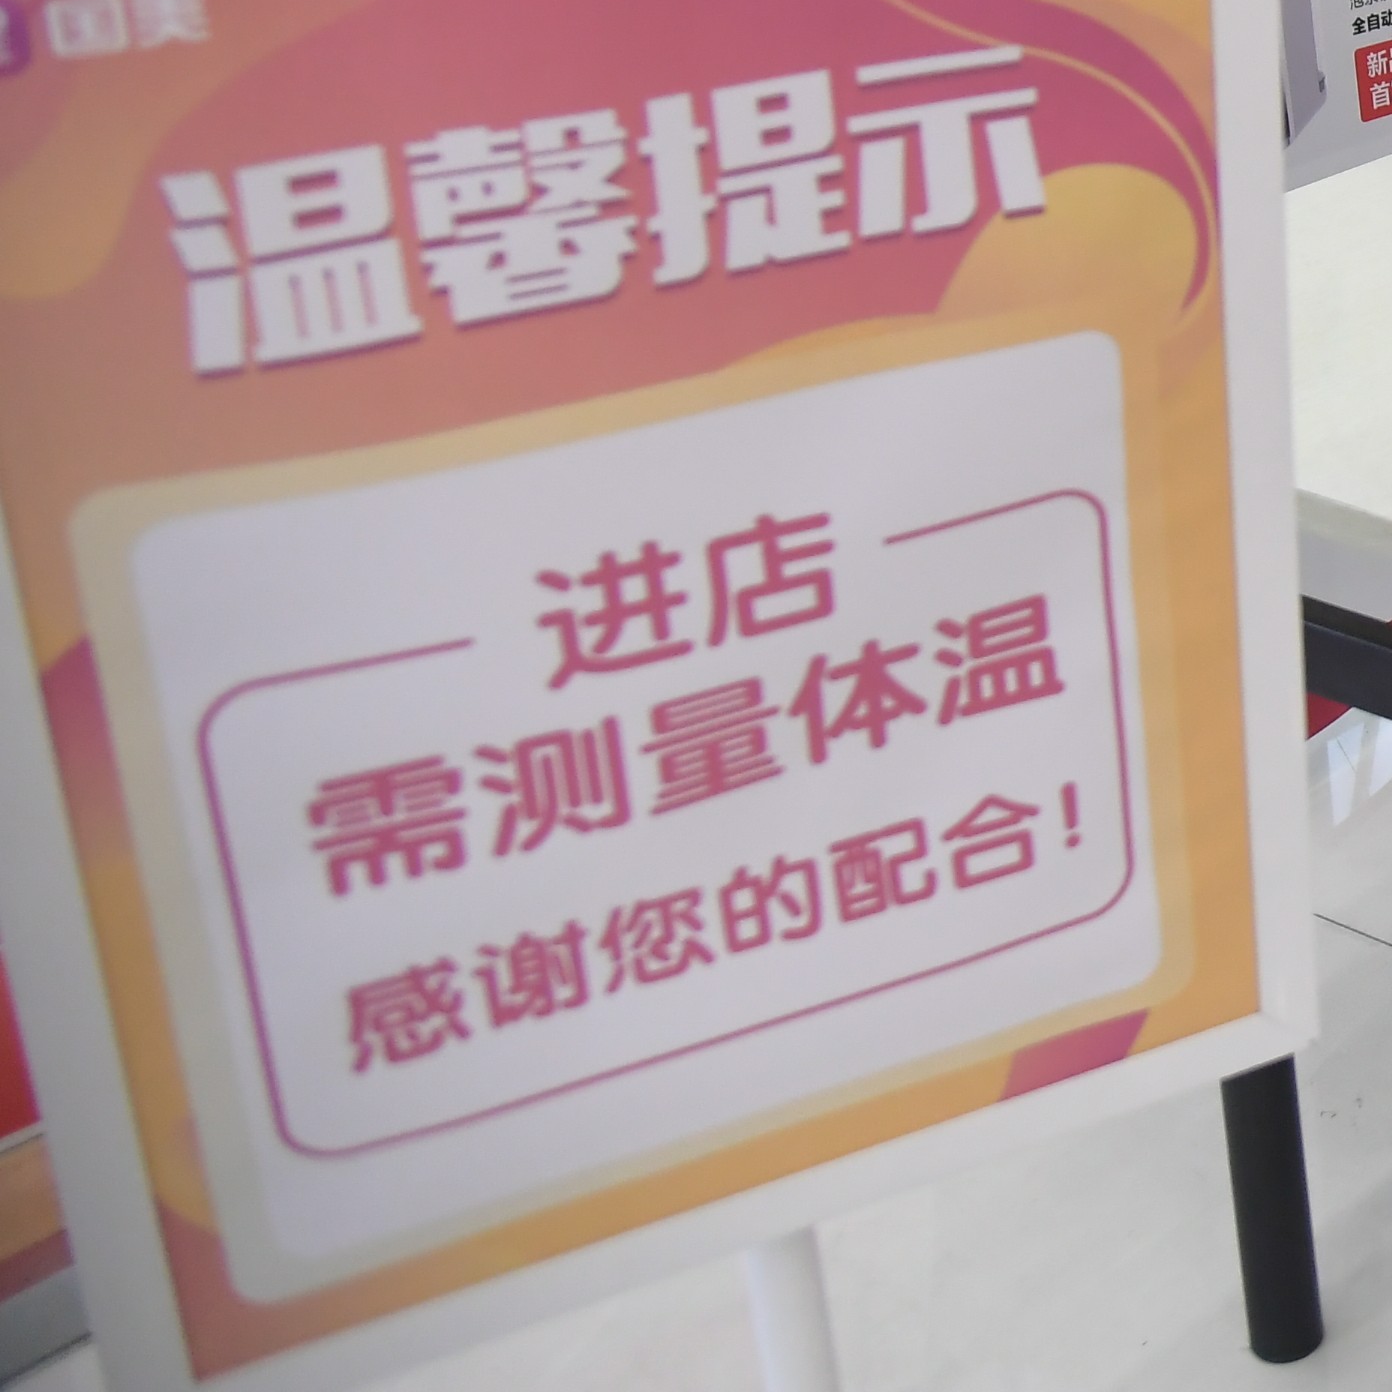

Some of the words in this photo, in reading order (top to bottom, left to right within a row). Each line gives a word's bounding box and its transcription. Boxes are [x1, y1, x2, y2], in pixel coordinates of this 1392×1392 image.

[159, 45, 1047, 378] 温馨提示
[307, 593, 1066, 898] 需测量体温
[534, 511, 836, 690] 进店
[347, 782, 1088, 1076] 感谢您的配合!
